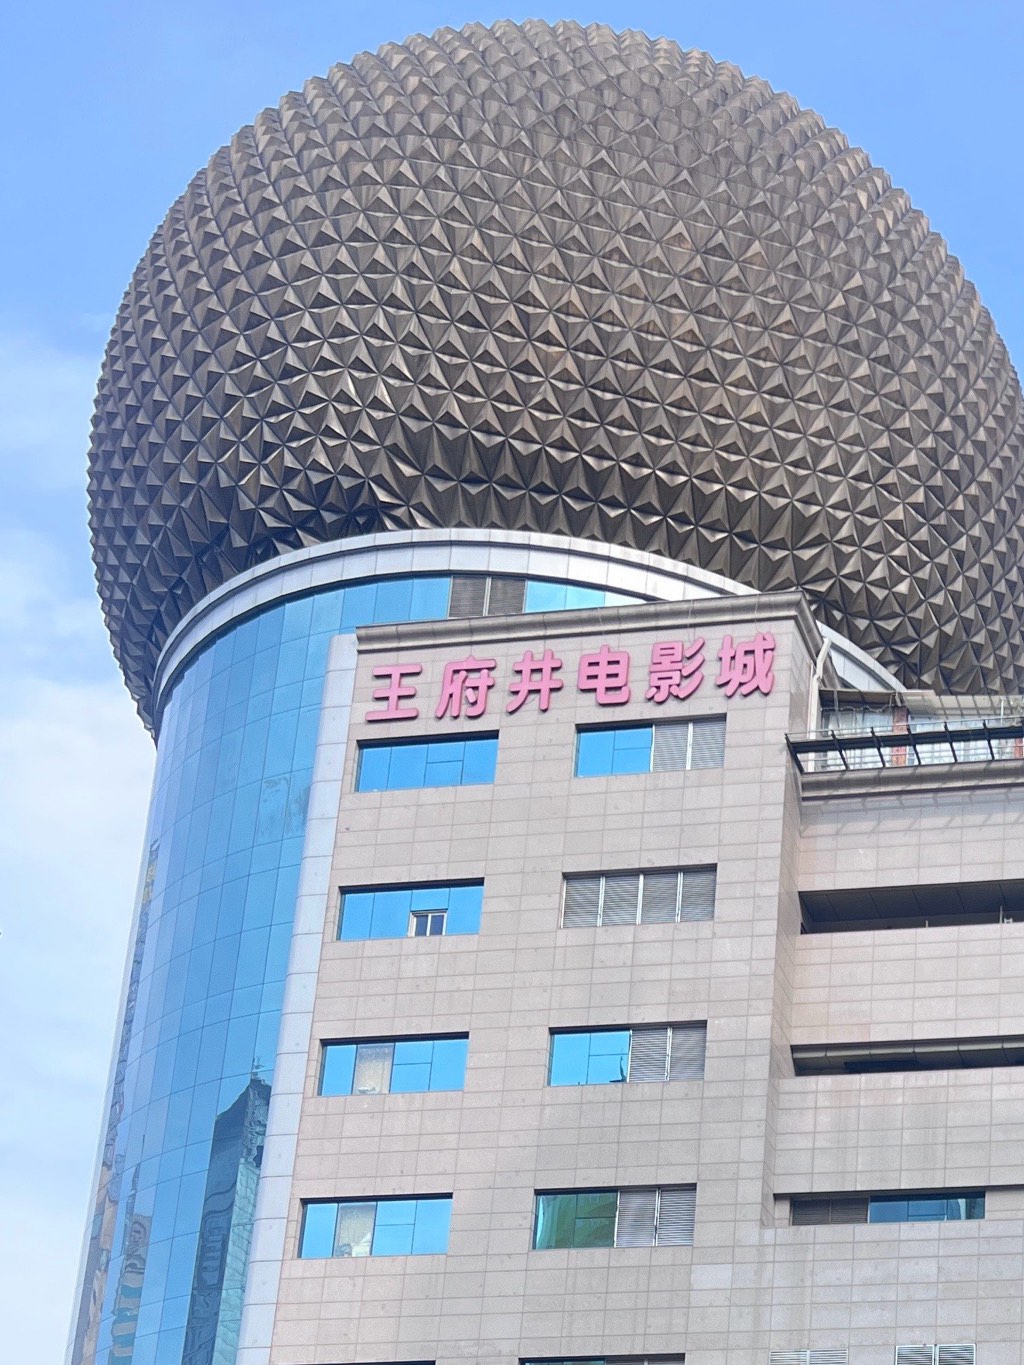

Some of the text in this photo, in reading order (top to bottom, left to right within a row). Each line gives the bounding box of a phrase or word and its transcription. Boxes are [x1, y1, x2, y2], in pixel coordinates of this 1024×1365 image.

[365, 632, 778, 722] 王府井电影城
